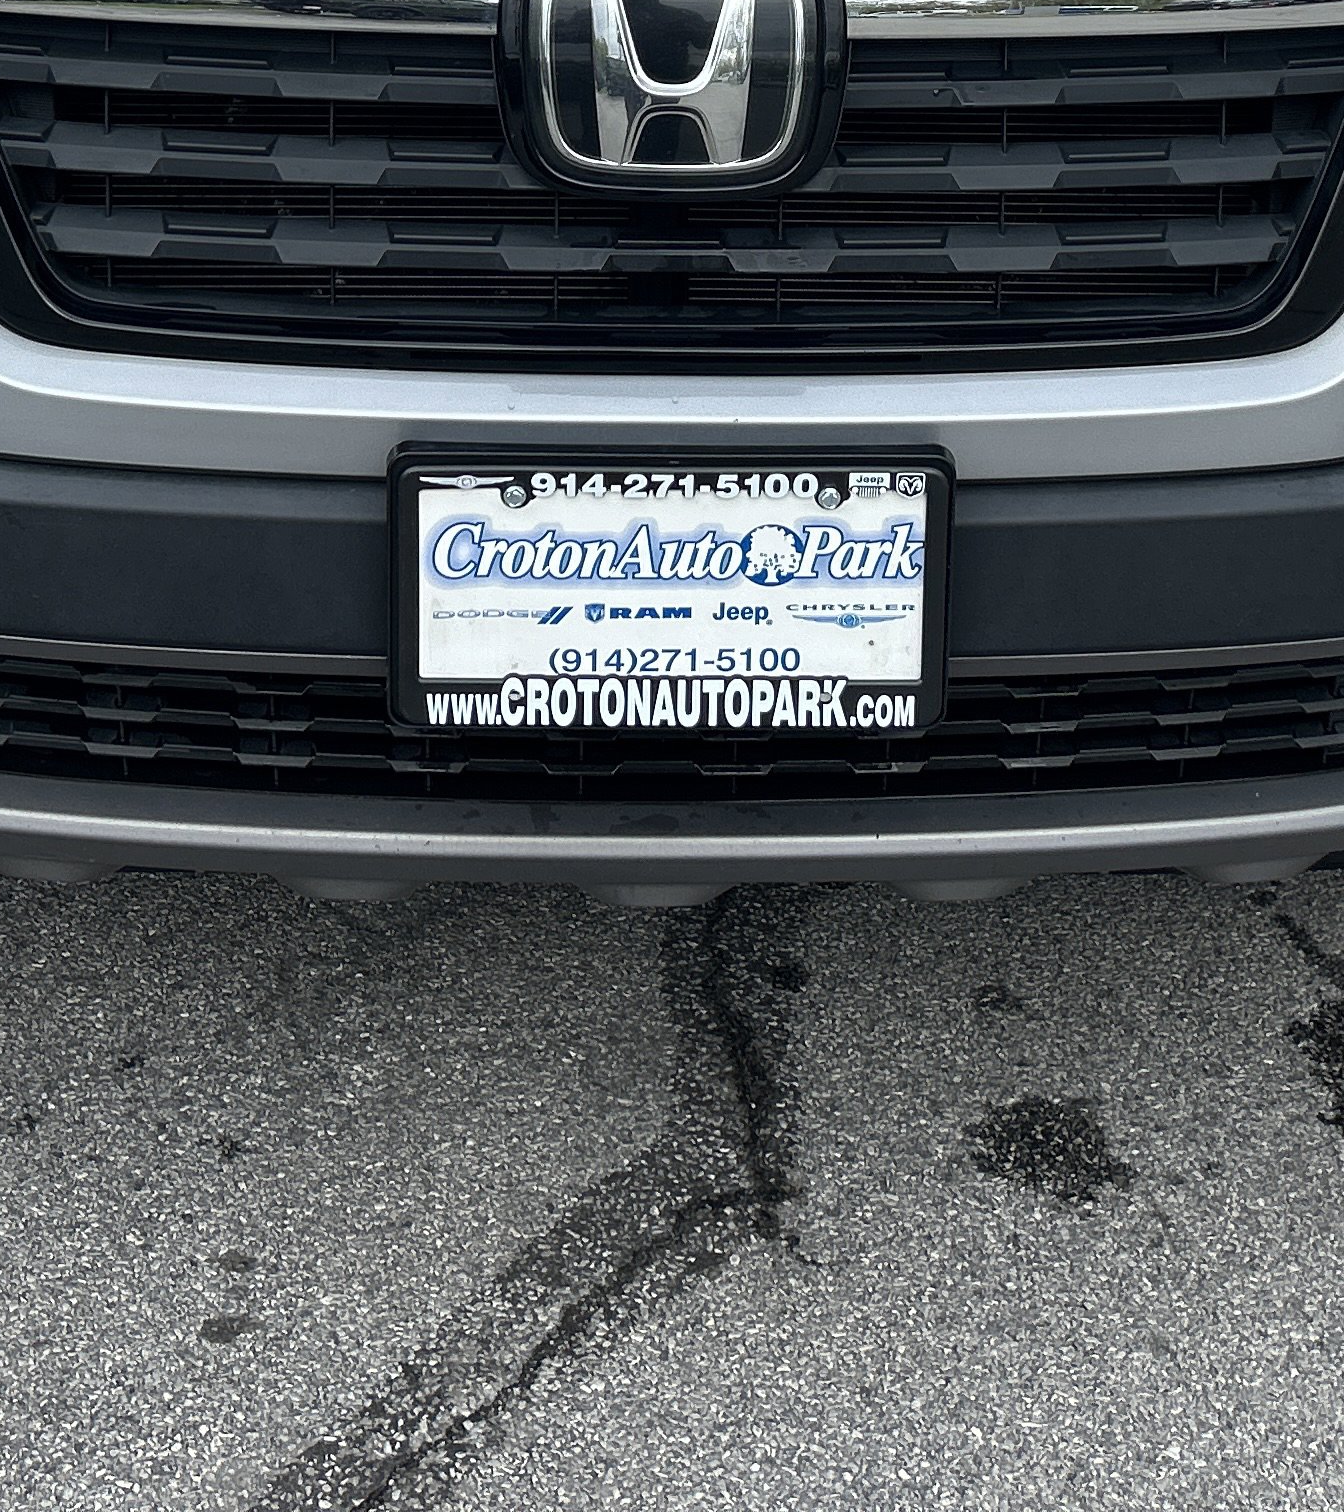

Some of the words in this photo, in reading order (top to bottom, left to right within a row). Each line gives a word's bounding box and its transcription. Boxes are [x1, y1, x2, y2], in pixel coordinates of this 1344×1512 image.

[531, 472, 818, 498] 914-271-5100
[855, 474, 885, 484] Jeep
[793, 522, 924, 579] Park
[432, 609, 552, 619] DODGE
[609, 606, 692, 619] RAM
[712, 602, 770, 625] Jeep
[786, 603, 915, 611] CHRYSLER
[549, 648, 801, 673] (914)271-5100
